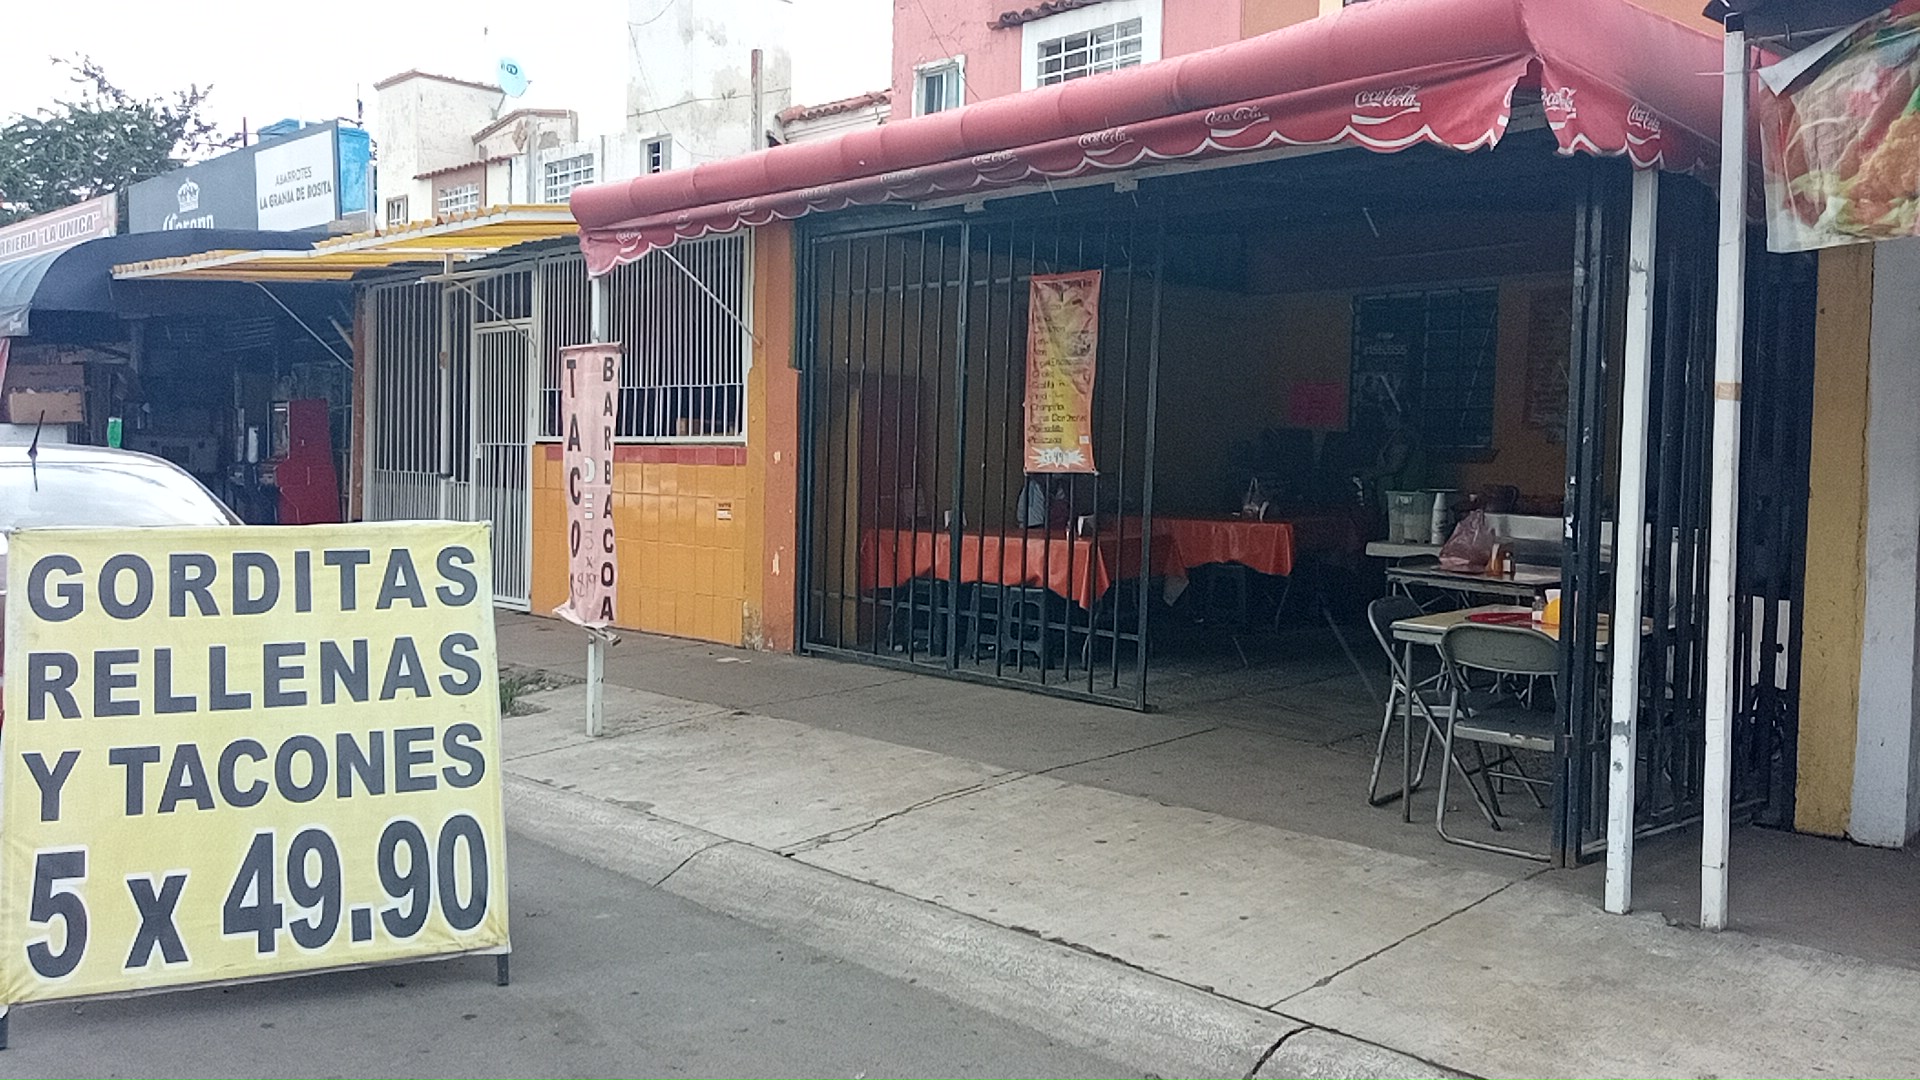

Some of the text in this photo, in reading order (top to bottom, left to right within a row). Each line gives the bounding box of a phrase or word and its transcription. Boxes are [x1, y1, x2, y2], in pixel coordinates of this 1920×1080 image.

[259, 180, 332, 210] LA GRANJA DE ROSITA
[275, 165, 312, 187] ABARROTES
[566, 359, 582, 610] TACOS
[600, 357, 615, 620] BARBACOA
[27, 546, 478, 622] GORDITAS
[27, 633, 482, 721] RELLENAS
[21, 723, 486, 822] Y TACONES
[27, 850, 88, 979] 5
[223, 814, 488, 954] 49.90
